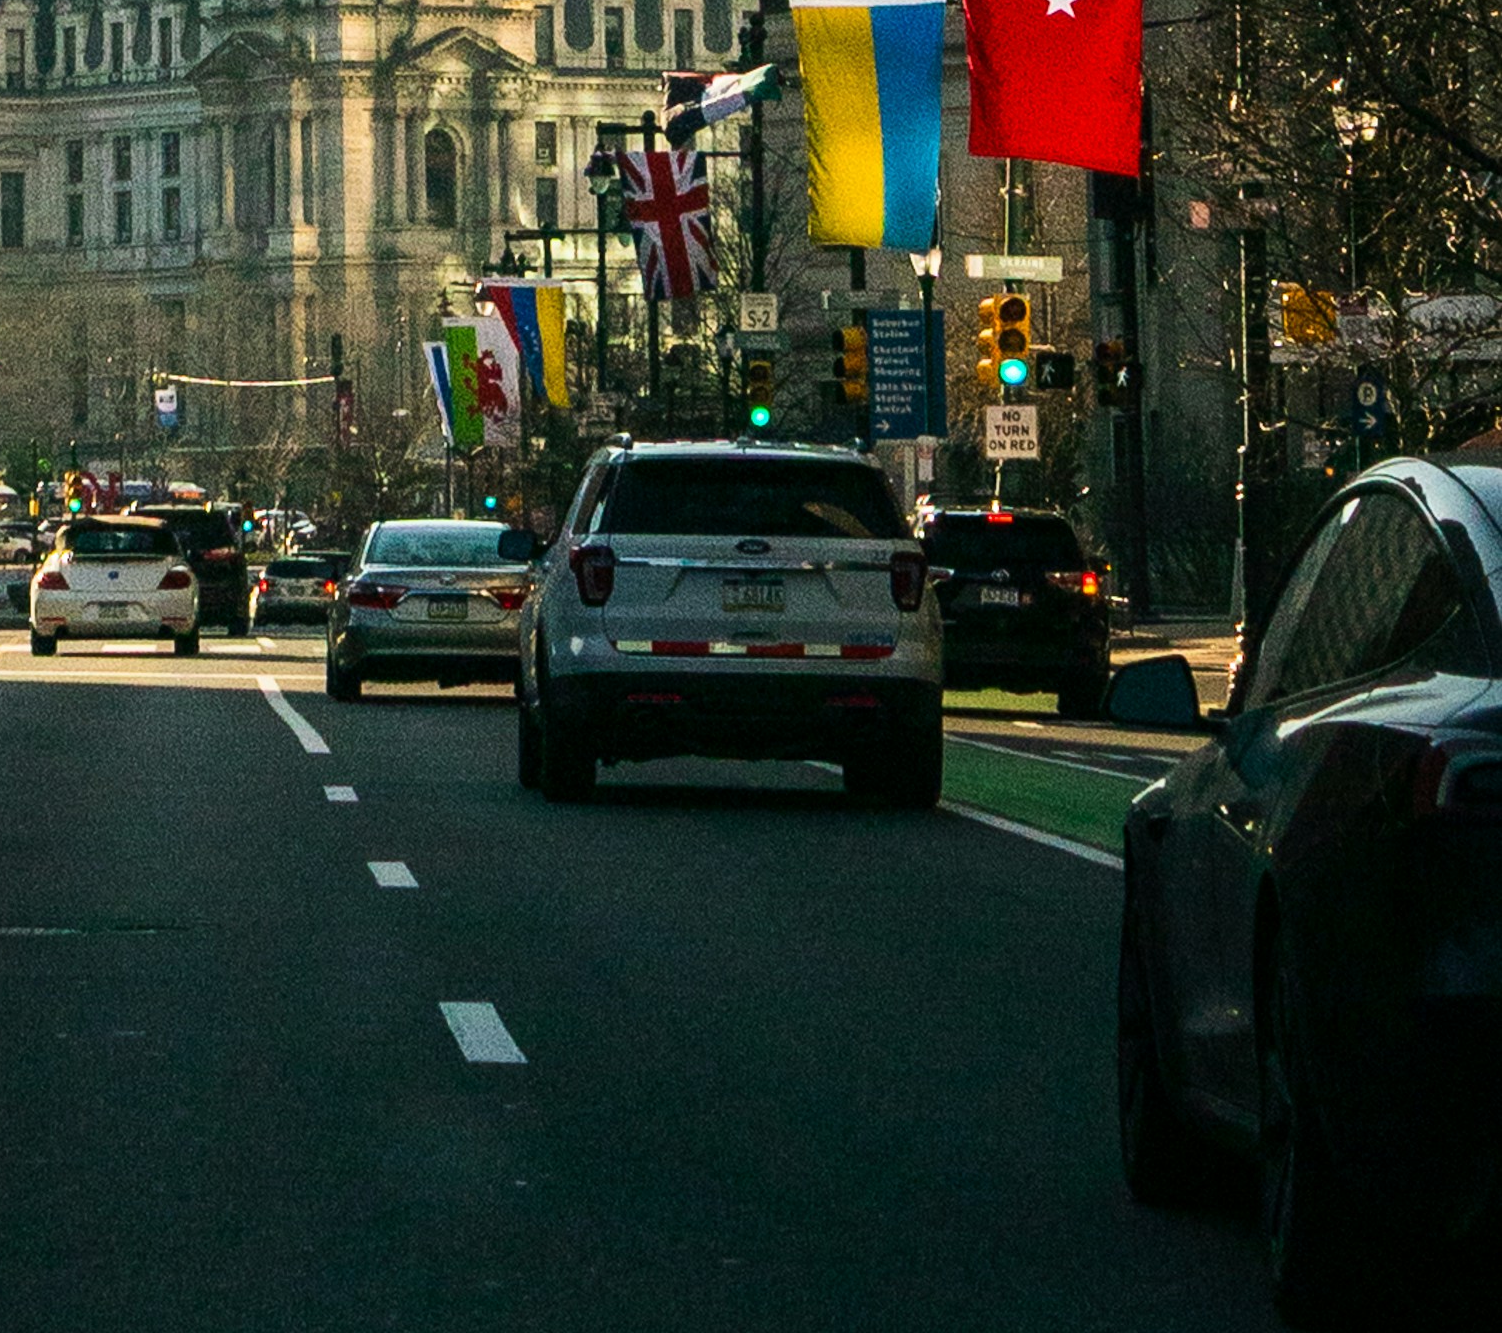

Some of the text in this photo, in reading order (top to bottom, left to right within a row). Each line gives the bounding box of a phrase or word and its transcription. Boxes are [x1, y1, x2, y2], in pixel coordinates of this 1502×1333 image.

[747, 310, 770, 328] S-2
[872, 318, 920, 327] Suburban
[872, 329, 910, 338] Station
[874, 356, 910, 365] Walnut
[874, 367, 921, 377] Shopping
[875, 394, 912, 403] Station
[875, 404, 912, 413] Amtrak
[1002, 411, 1020, 421] NO
[994, 424, 1029, 436] TURN
[989, 440, 1035, 451] ON RED
